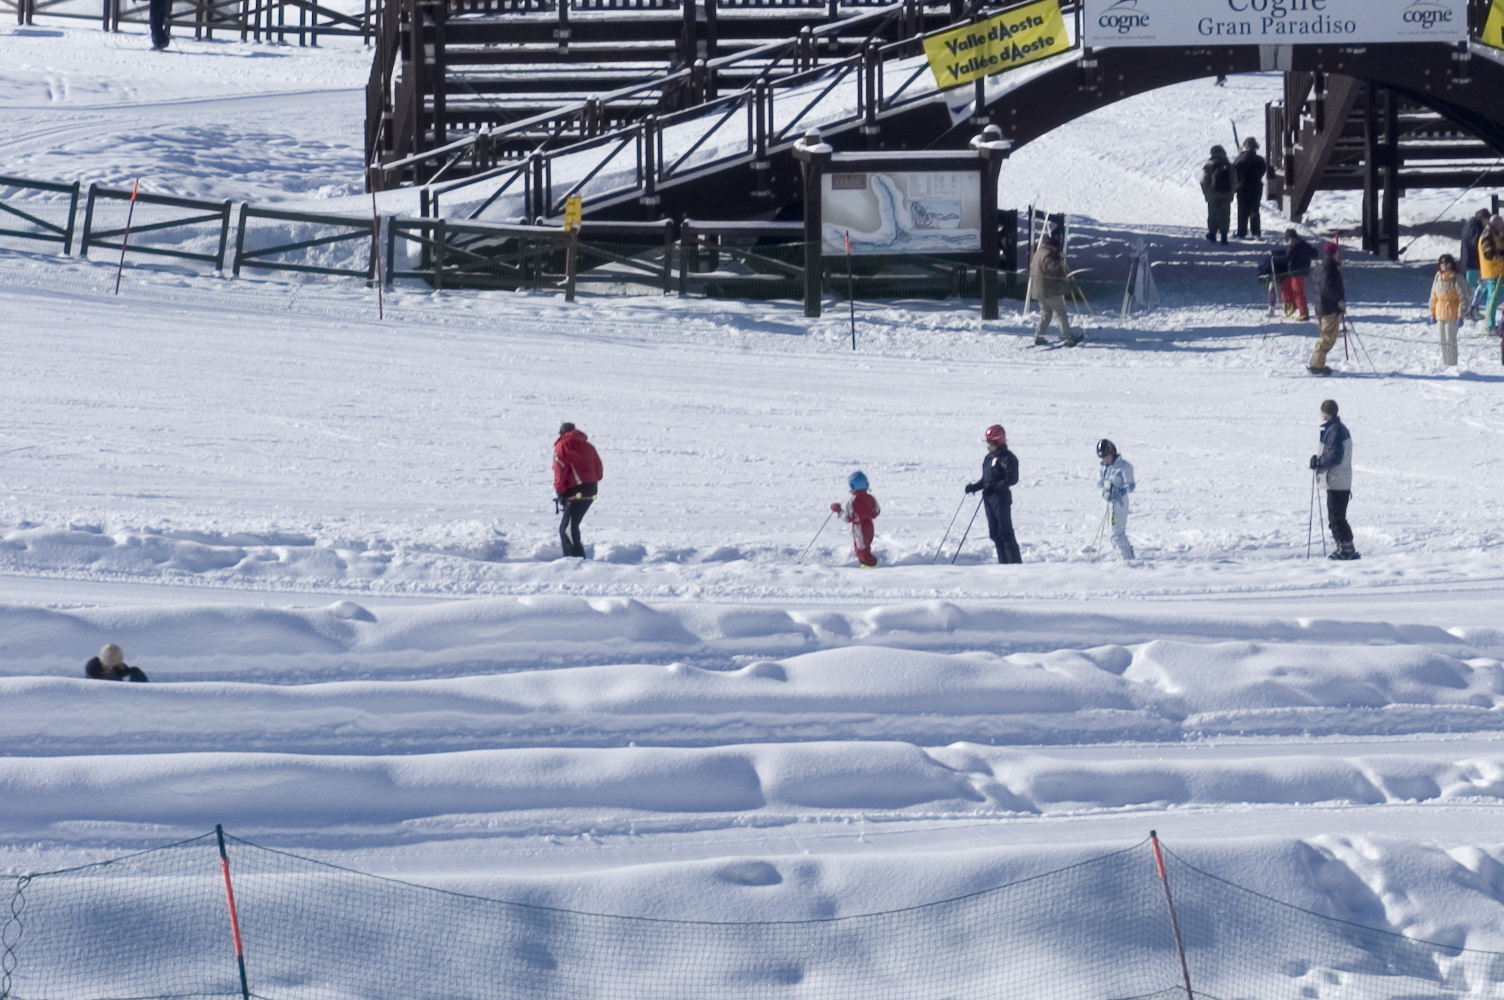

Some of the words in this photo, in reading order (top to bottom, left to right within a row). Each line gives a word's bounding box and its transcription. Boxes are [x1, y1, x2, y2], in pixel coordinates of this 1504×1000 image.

[1098, 14, 1150, 34] cogne
[1198, 17, 1251, 36] Gran
[1261, 14, 1356, 35] Paradiso
[1402, 9, 1453, 29] cogne
[945, 33, 986, 57] Valle
[947, 55, 998, 80] Vallée
